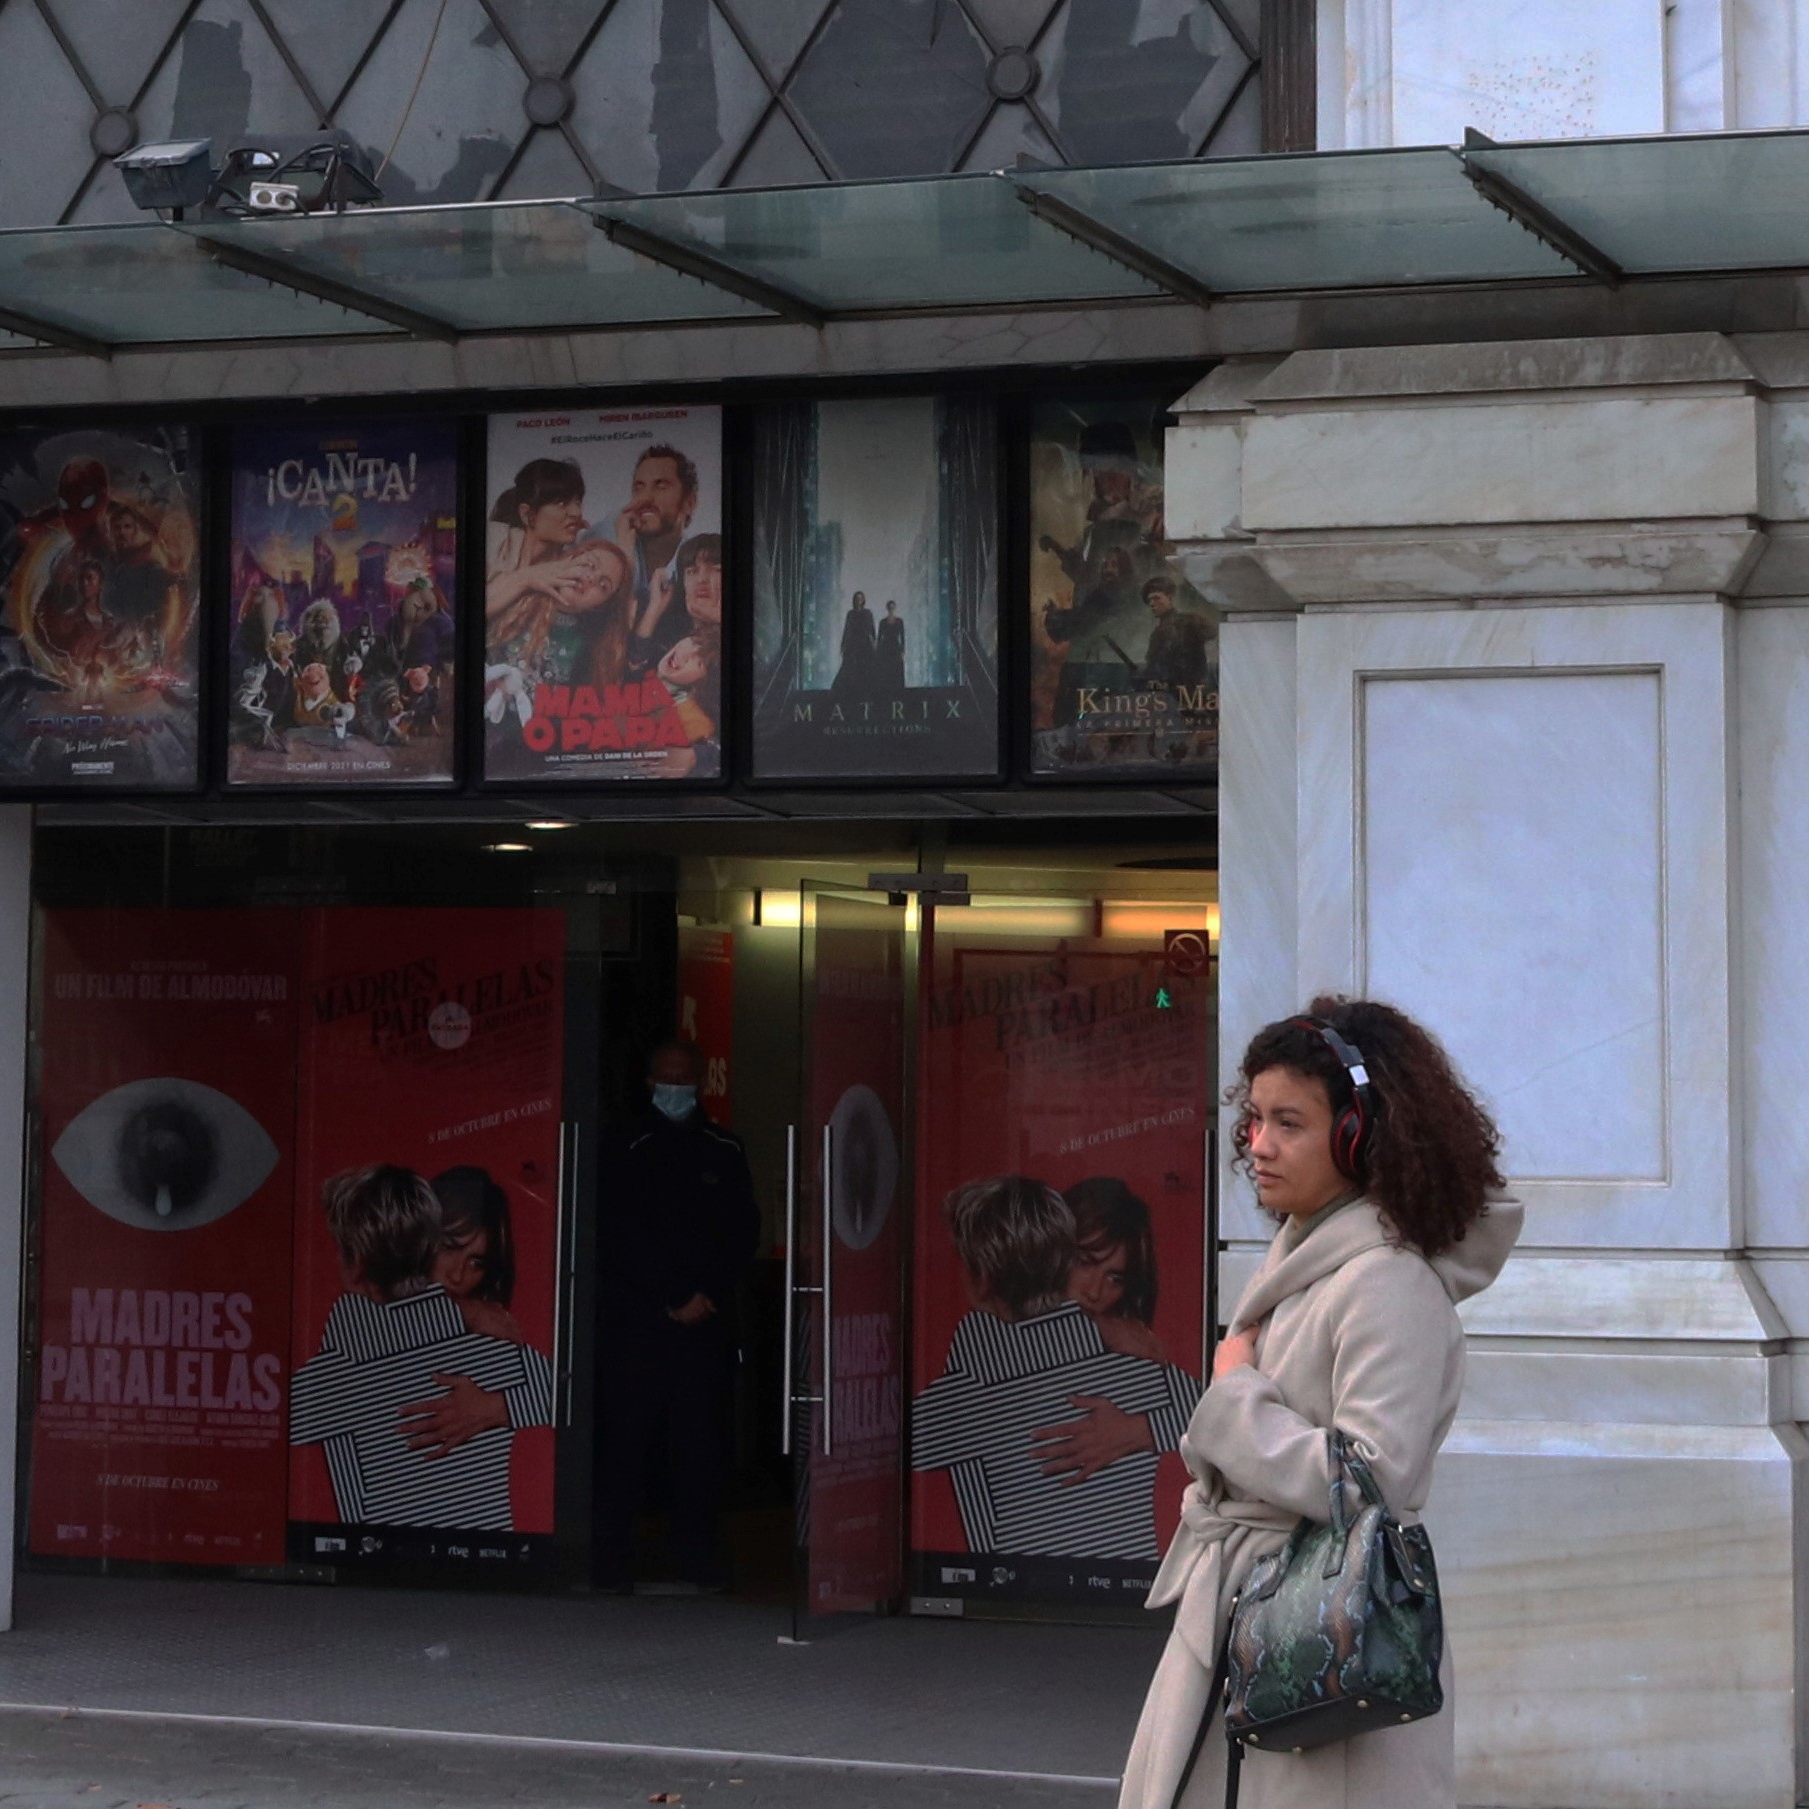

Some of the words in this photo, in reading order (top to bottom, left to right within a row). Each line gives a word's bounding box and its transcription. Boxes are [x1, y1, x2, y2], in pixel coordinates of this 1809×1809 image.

[332, 493, 359, 530] 2
[534, 669, 675, 718] MAMÁ
[1076, 687, 1168, 719] King's
[794, 700, 961, 723] MATRIX
[522, 716, 557, 753] O
[54, 973, 83, 999] UN
[85, 974, 135, 1000] FILM
[138, 974, 163, 1000] DE
[166, 968, 288, 1001] ALMODÓVAR
[311, 956, 438, 1025] MADRES
[453, 1113, 502, 1138] OCTUBRE
[520, 1096, 552, 1118] CINES
[1087, 1121, 1142, 1148] OCTUBRE
[70, 1287, 253, 1351] MADRES
[40, 1344, 282, 1412] PARALELAS
[121, 1474, 170, 1489] OCTUBRE
[171, 1477, 187, 1490] EN
[187, 1478, 221, 1493] CINES
[447, 1544, 469, 1559] rtve
[479, 1548, 507, 1559] NETFLIX
[1088, 1575, 1111, 1589] rtve
